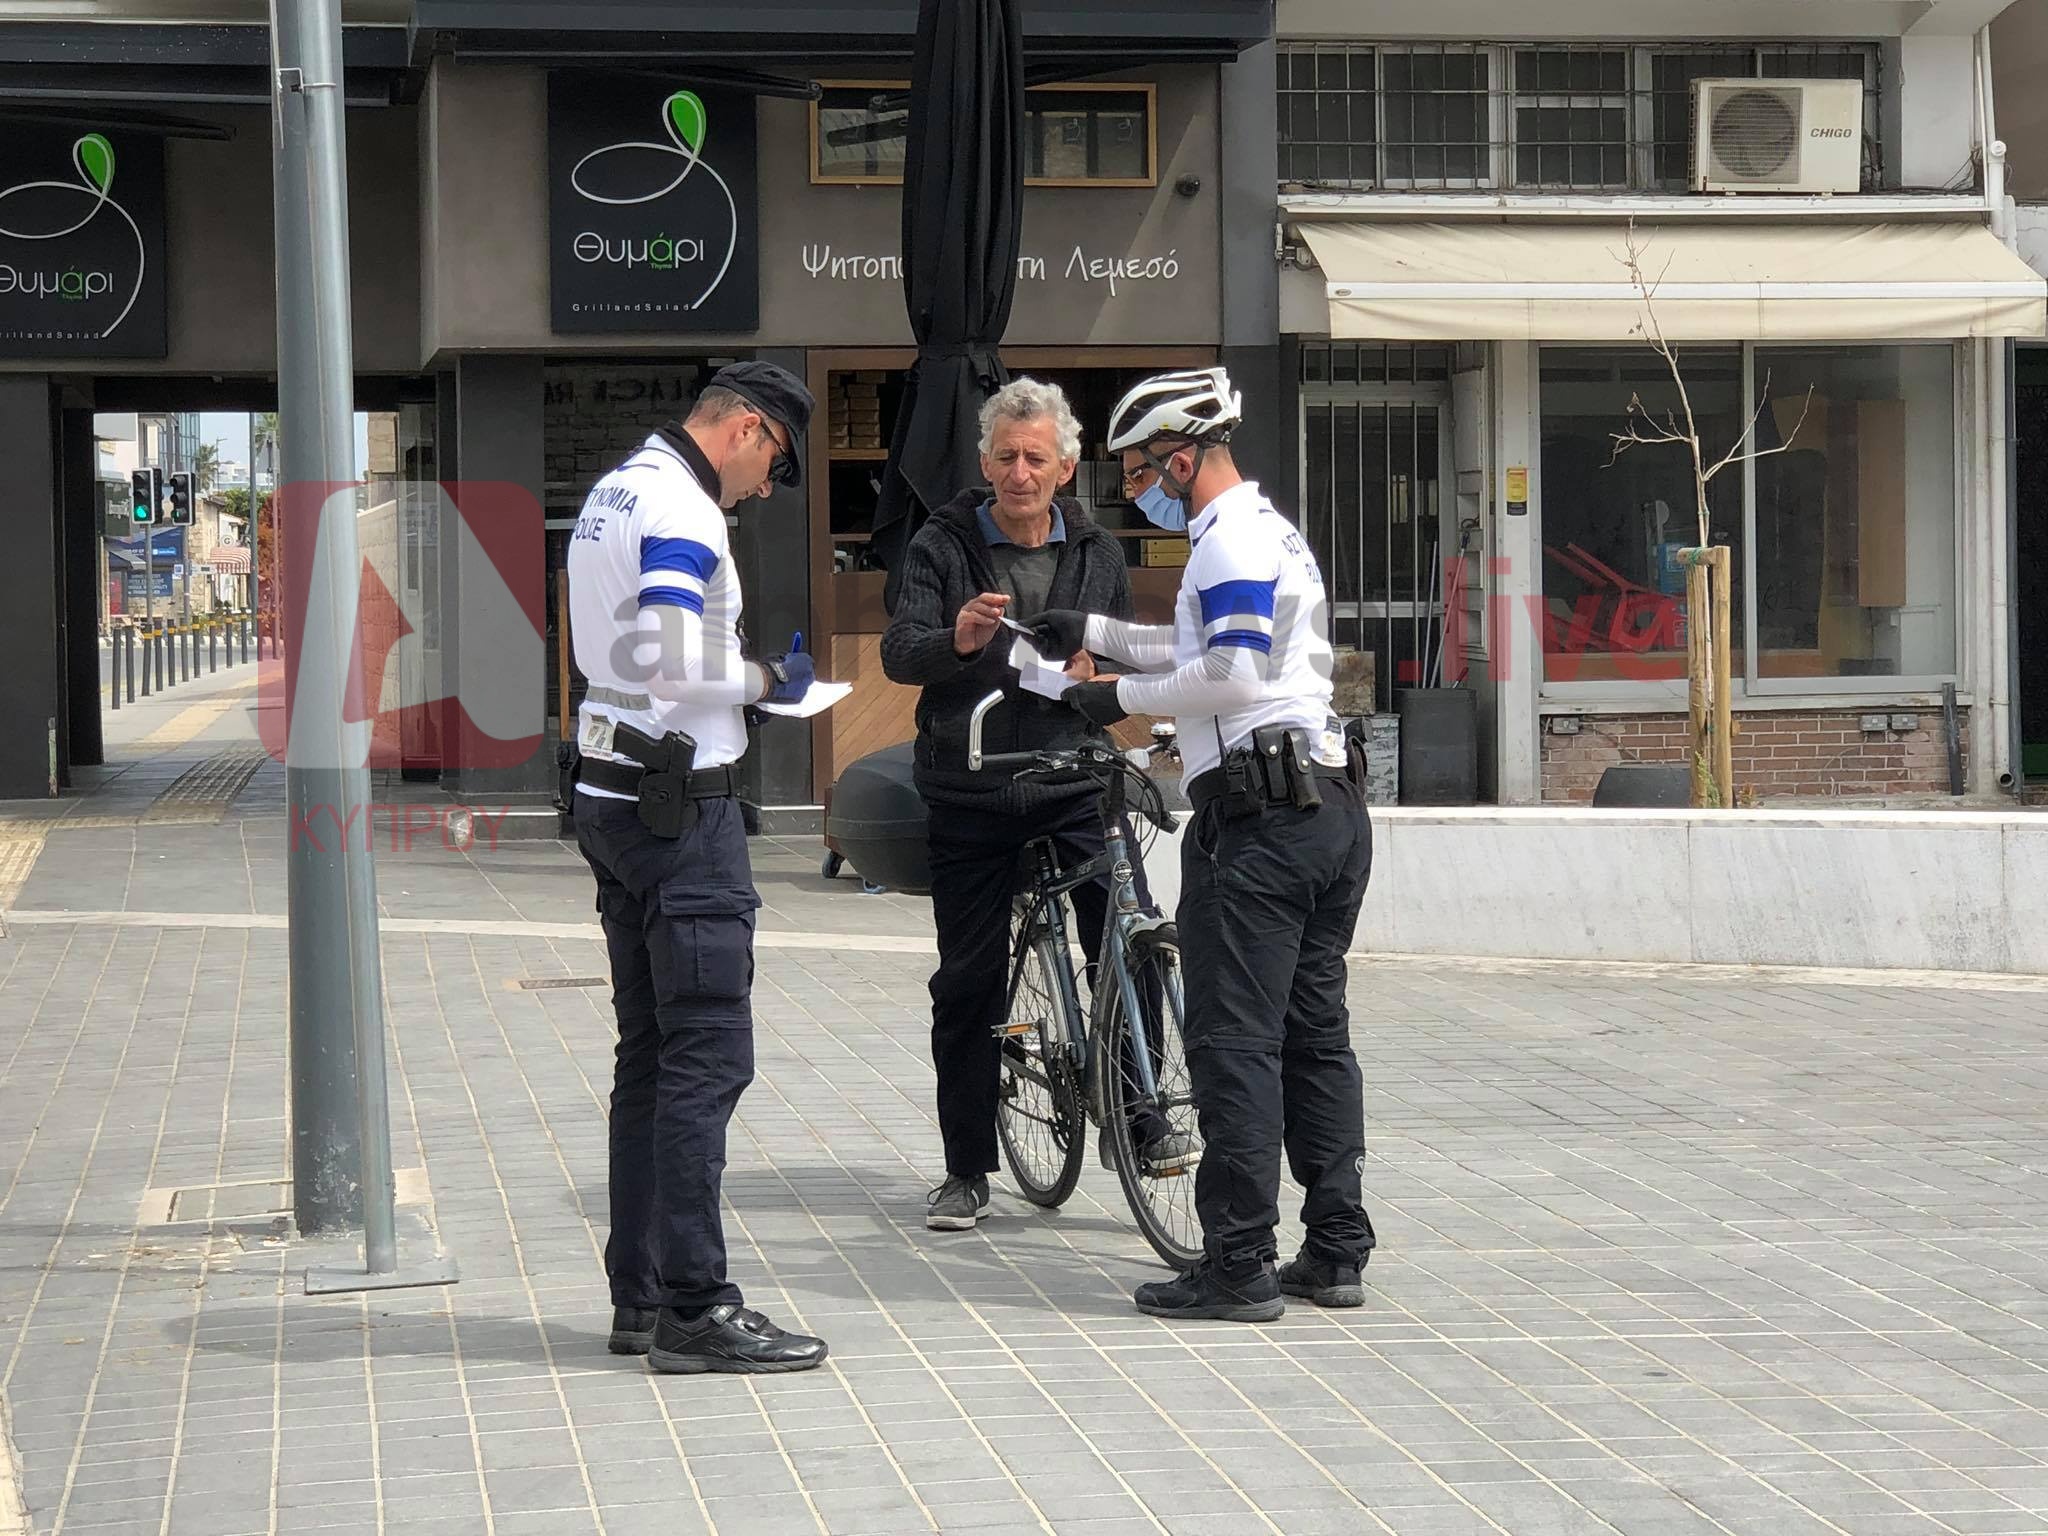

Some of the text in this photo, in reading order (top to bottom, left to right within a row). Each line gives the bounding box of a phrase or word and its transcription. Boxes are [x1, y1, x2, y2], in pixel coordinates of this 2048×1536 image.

[1810, 128, 1853, 138] CHIGO
[573, 231, 704, 269] Θυμάρι
[802, 244, 1179, 297] Ψητοπ τη Λεμεσό
